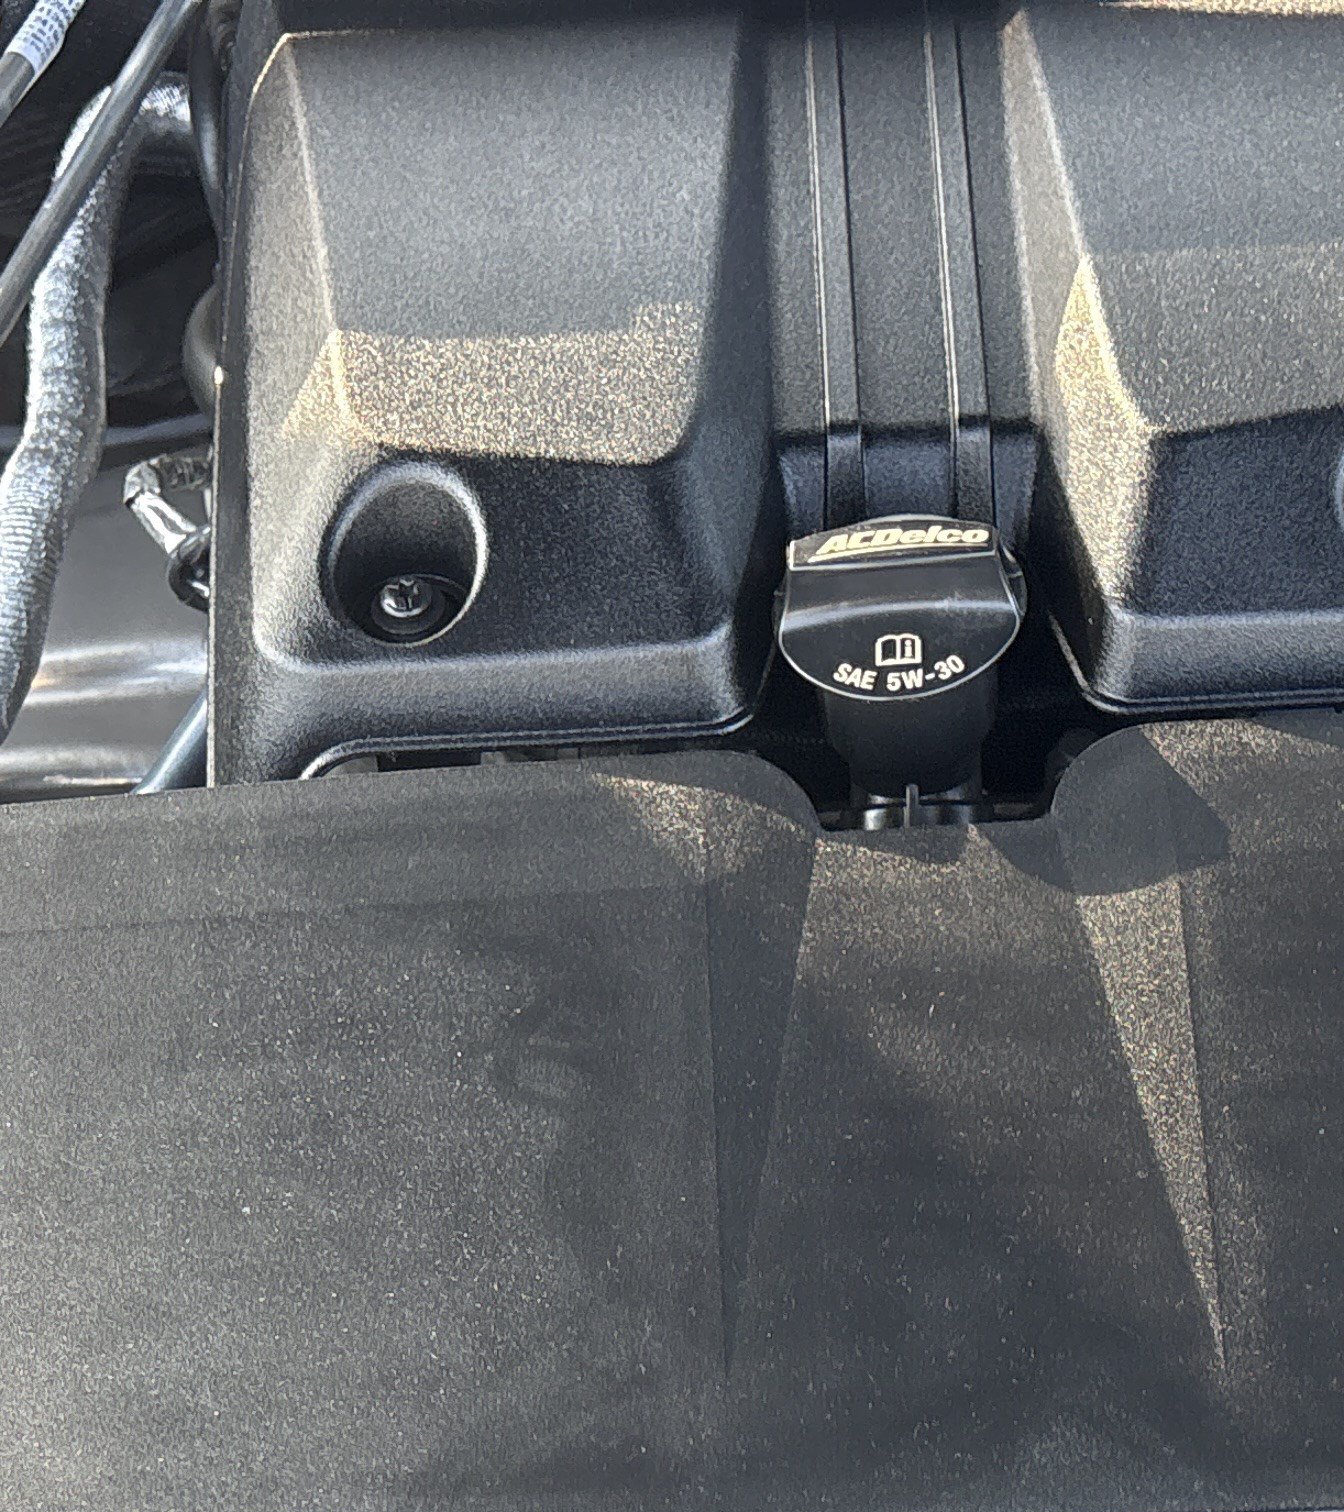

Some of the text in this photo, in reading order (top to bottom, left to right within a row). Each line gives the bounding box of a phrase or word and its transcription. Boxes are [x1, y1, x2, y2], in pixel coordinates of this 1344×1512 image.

[815, 525, 990, 555] ACDelco
[832, 654, 966, 692] SAE 5W-30
